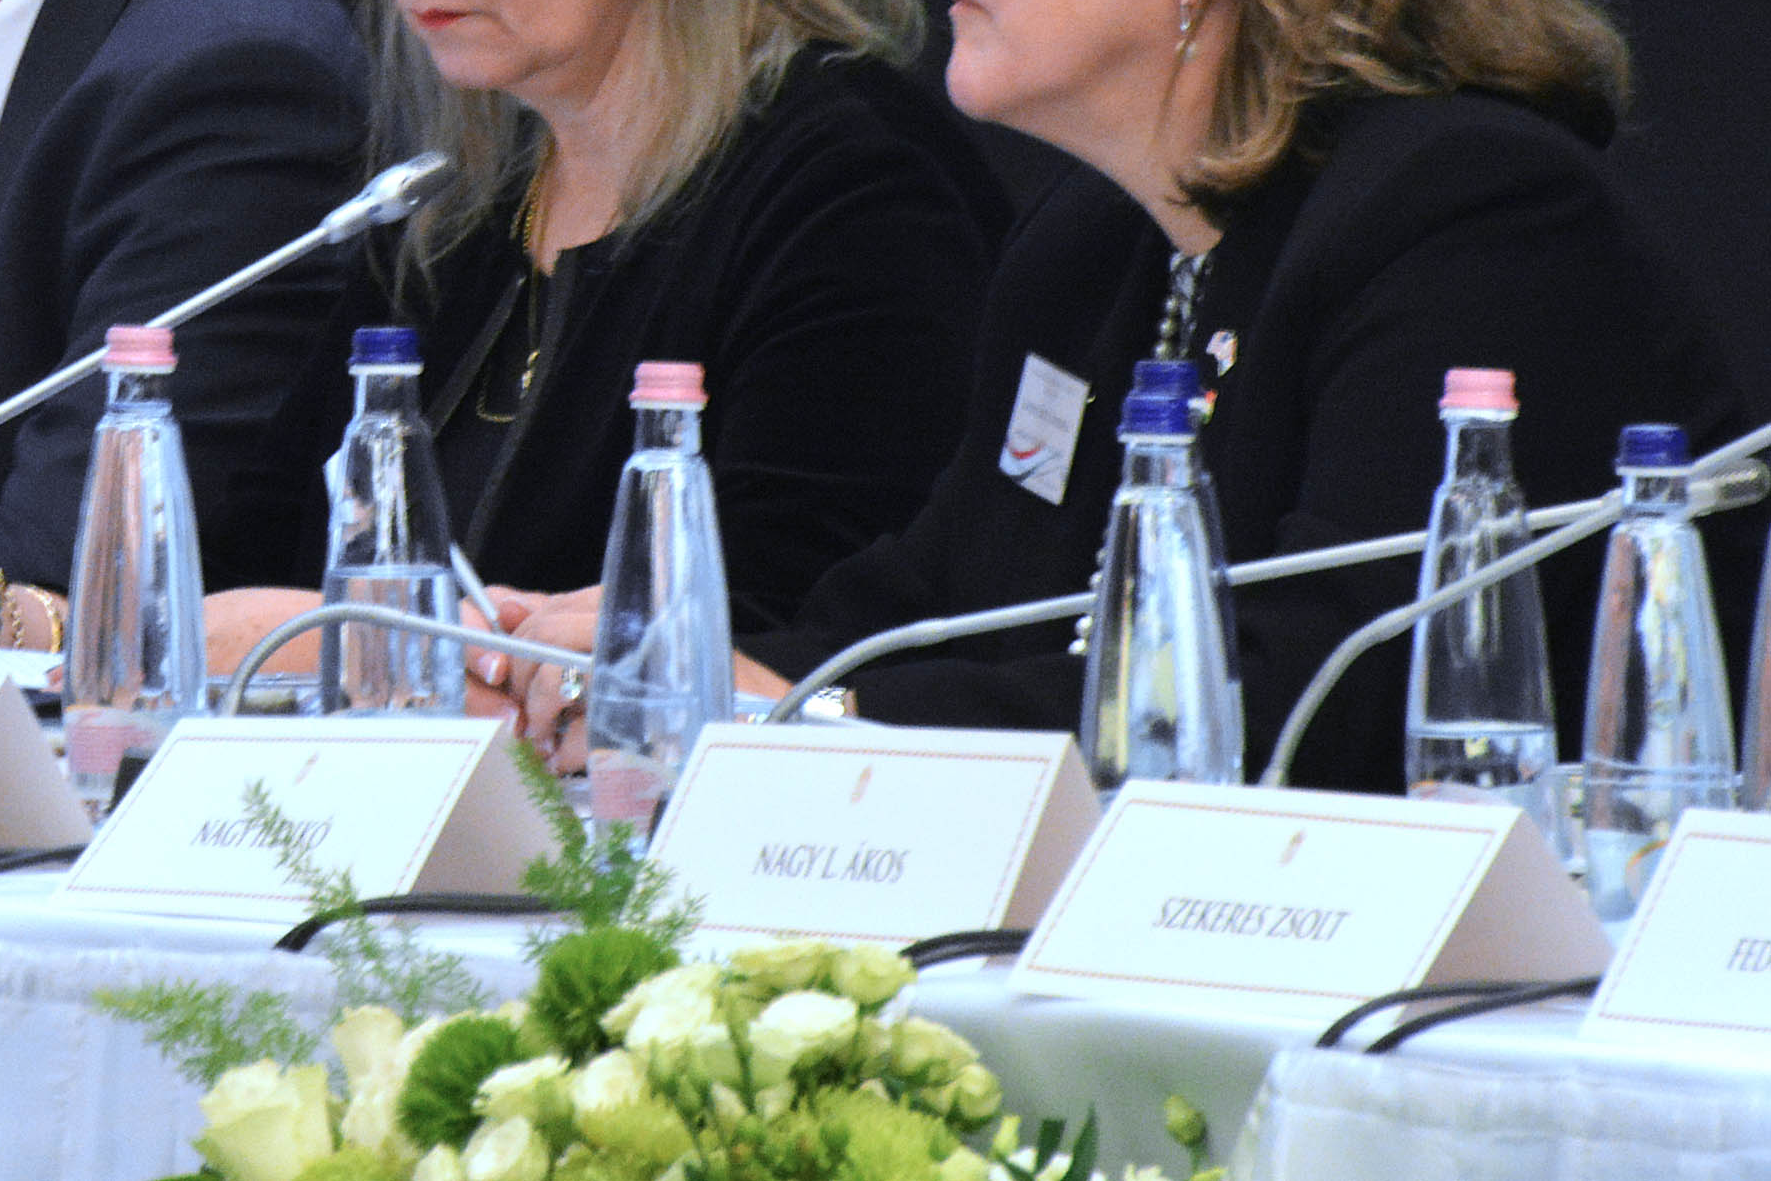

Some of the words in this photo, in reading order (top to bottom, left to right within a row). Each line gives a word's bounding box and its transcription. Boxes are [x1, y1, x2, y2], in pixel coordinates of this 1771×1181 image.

[752, 842, 826, 879] NAGY
[840, 839, 911, 883] ÁKOS
[1151, 896, 1272, 936] SZEKERES
[1266, 906, 1351, 941] ZSOLT
